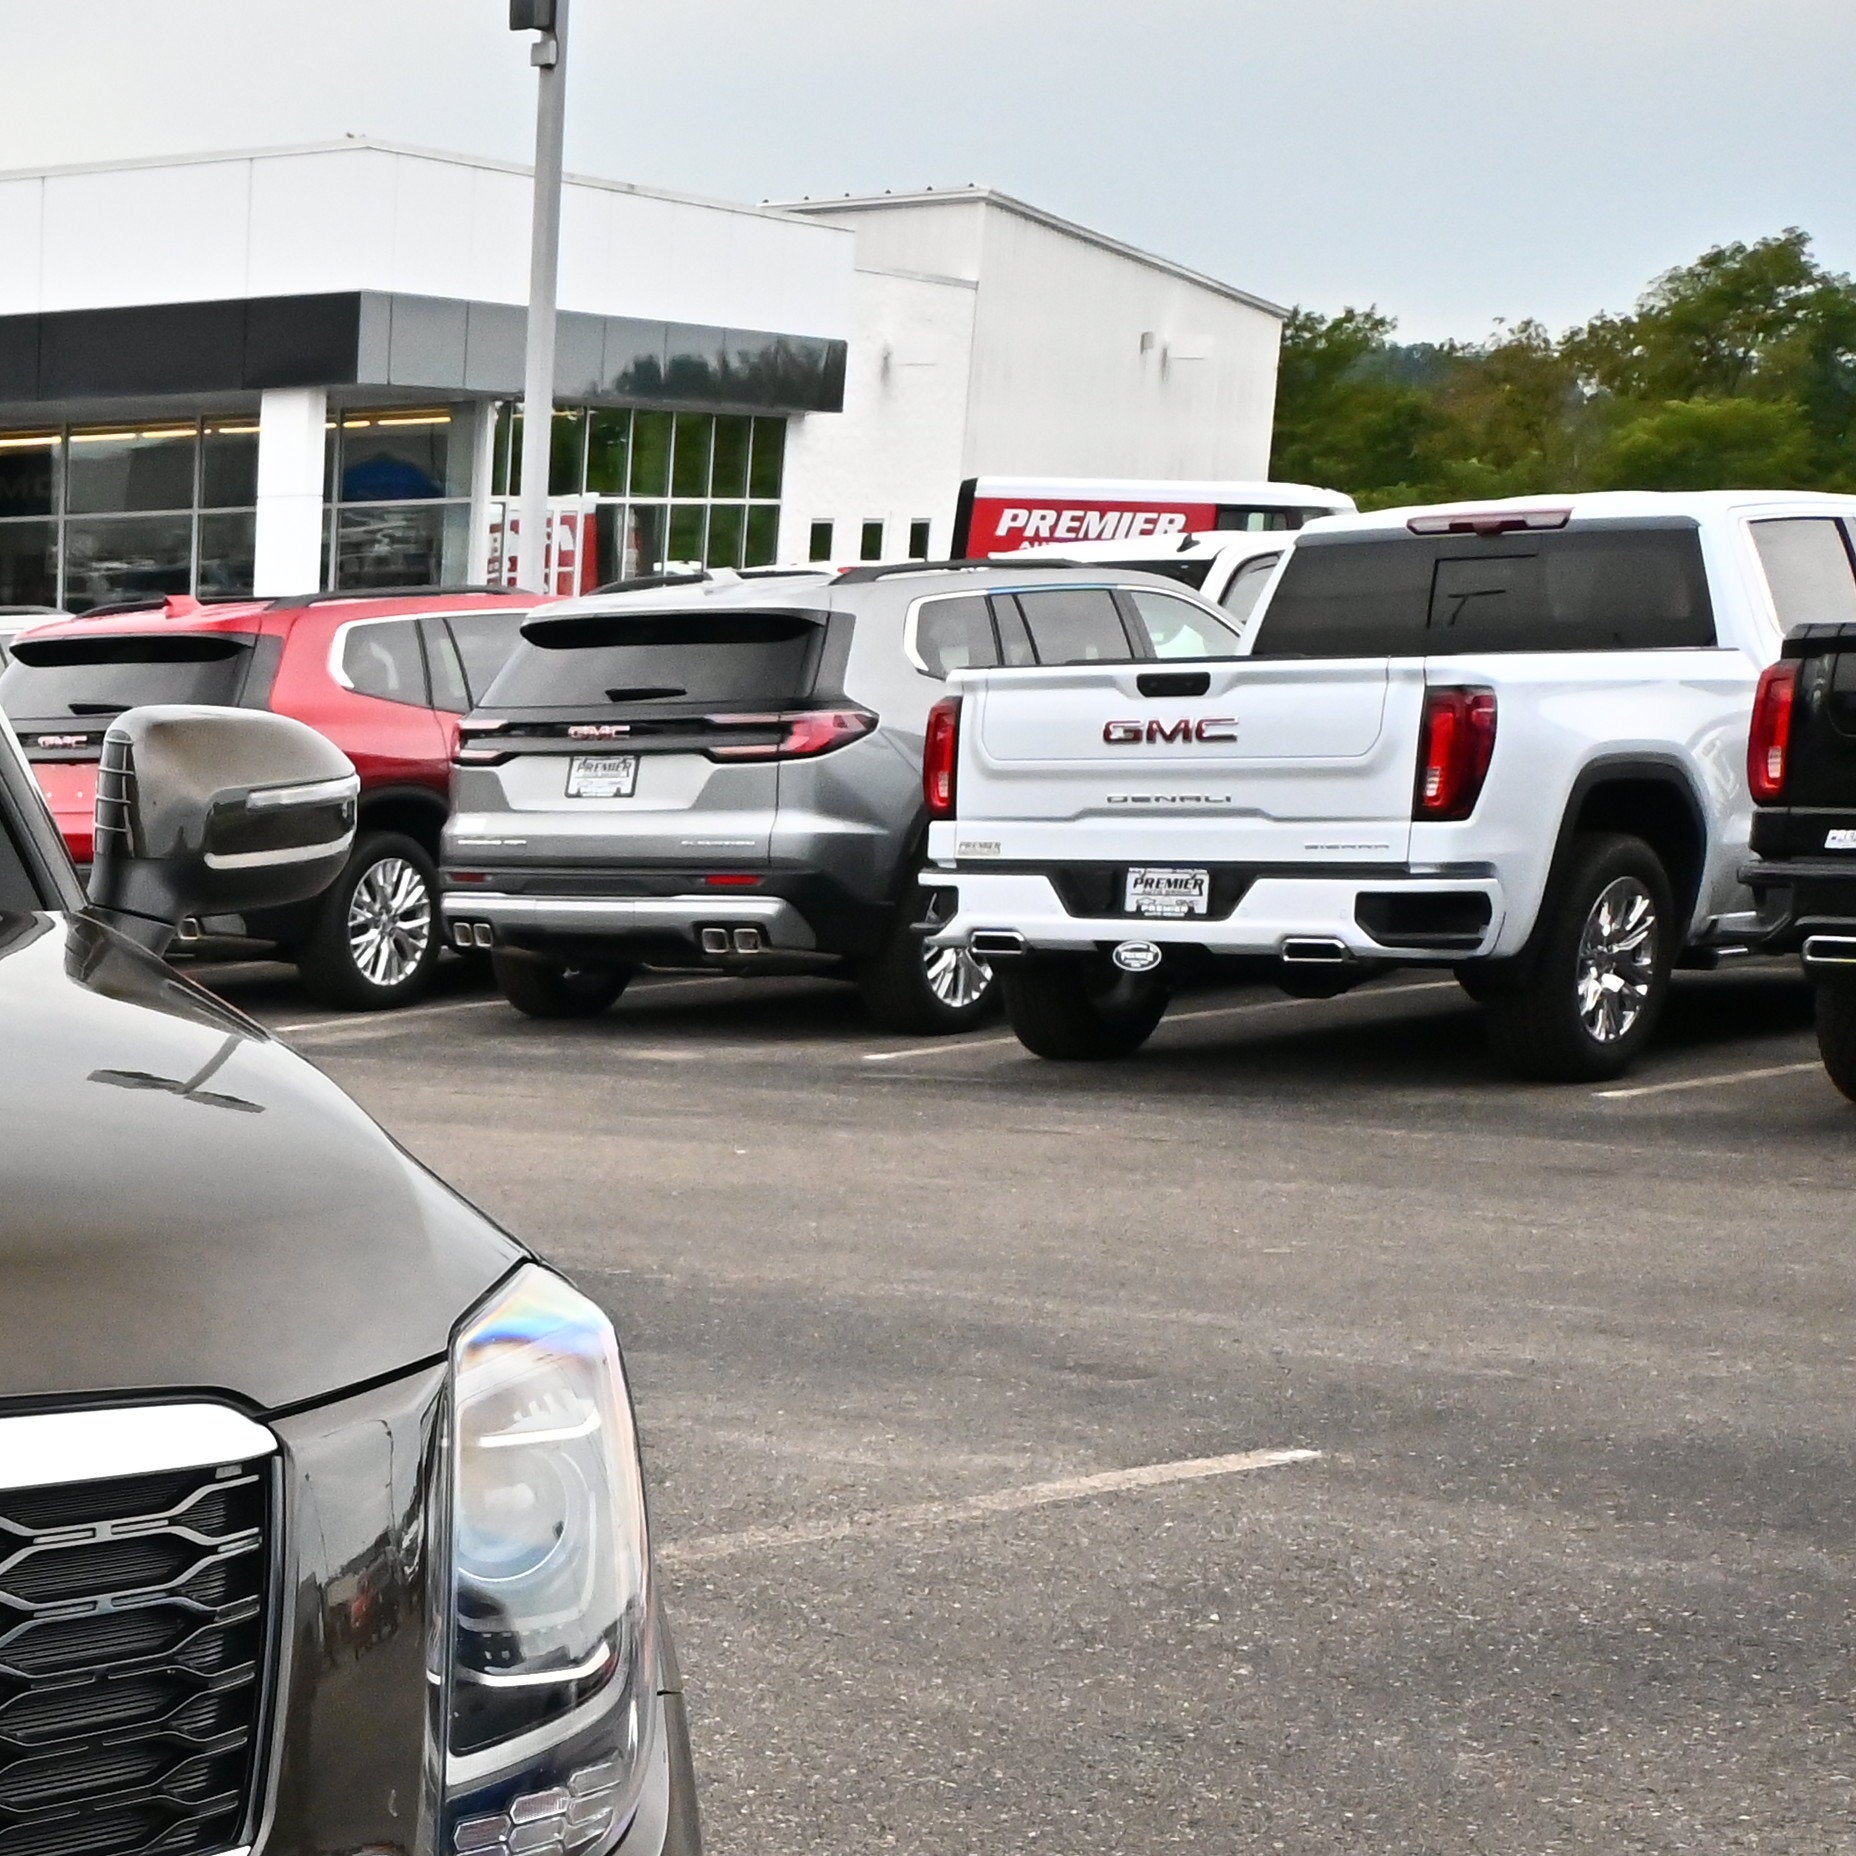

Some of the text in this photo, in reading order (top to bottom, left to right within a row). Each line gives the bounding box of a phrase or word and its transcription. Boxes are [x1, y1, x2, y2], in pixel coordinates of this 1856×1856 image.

[995, 508, 1187, 540] PREMIER
[569, 725, 631, 741] GMC
[1103, 718, 1239, 745] GMC
[1106, 795, 1232, 804] DENALI
[1133, 877, 1205, 893] PREMIER
